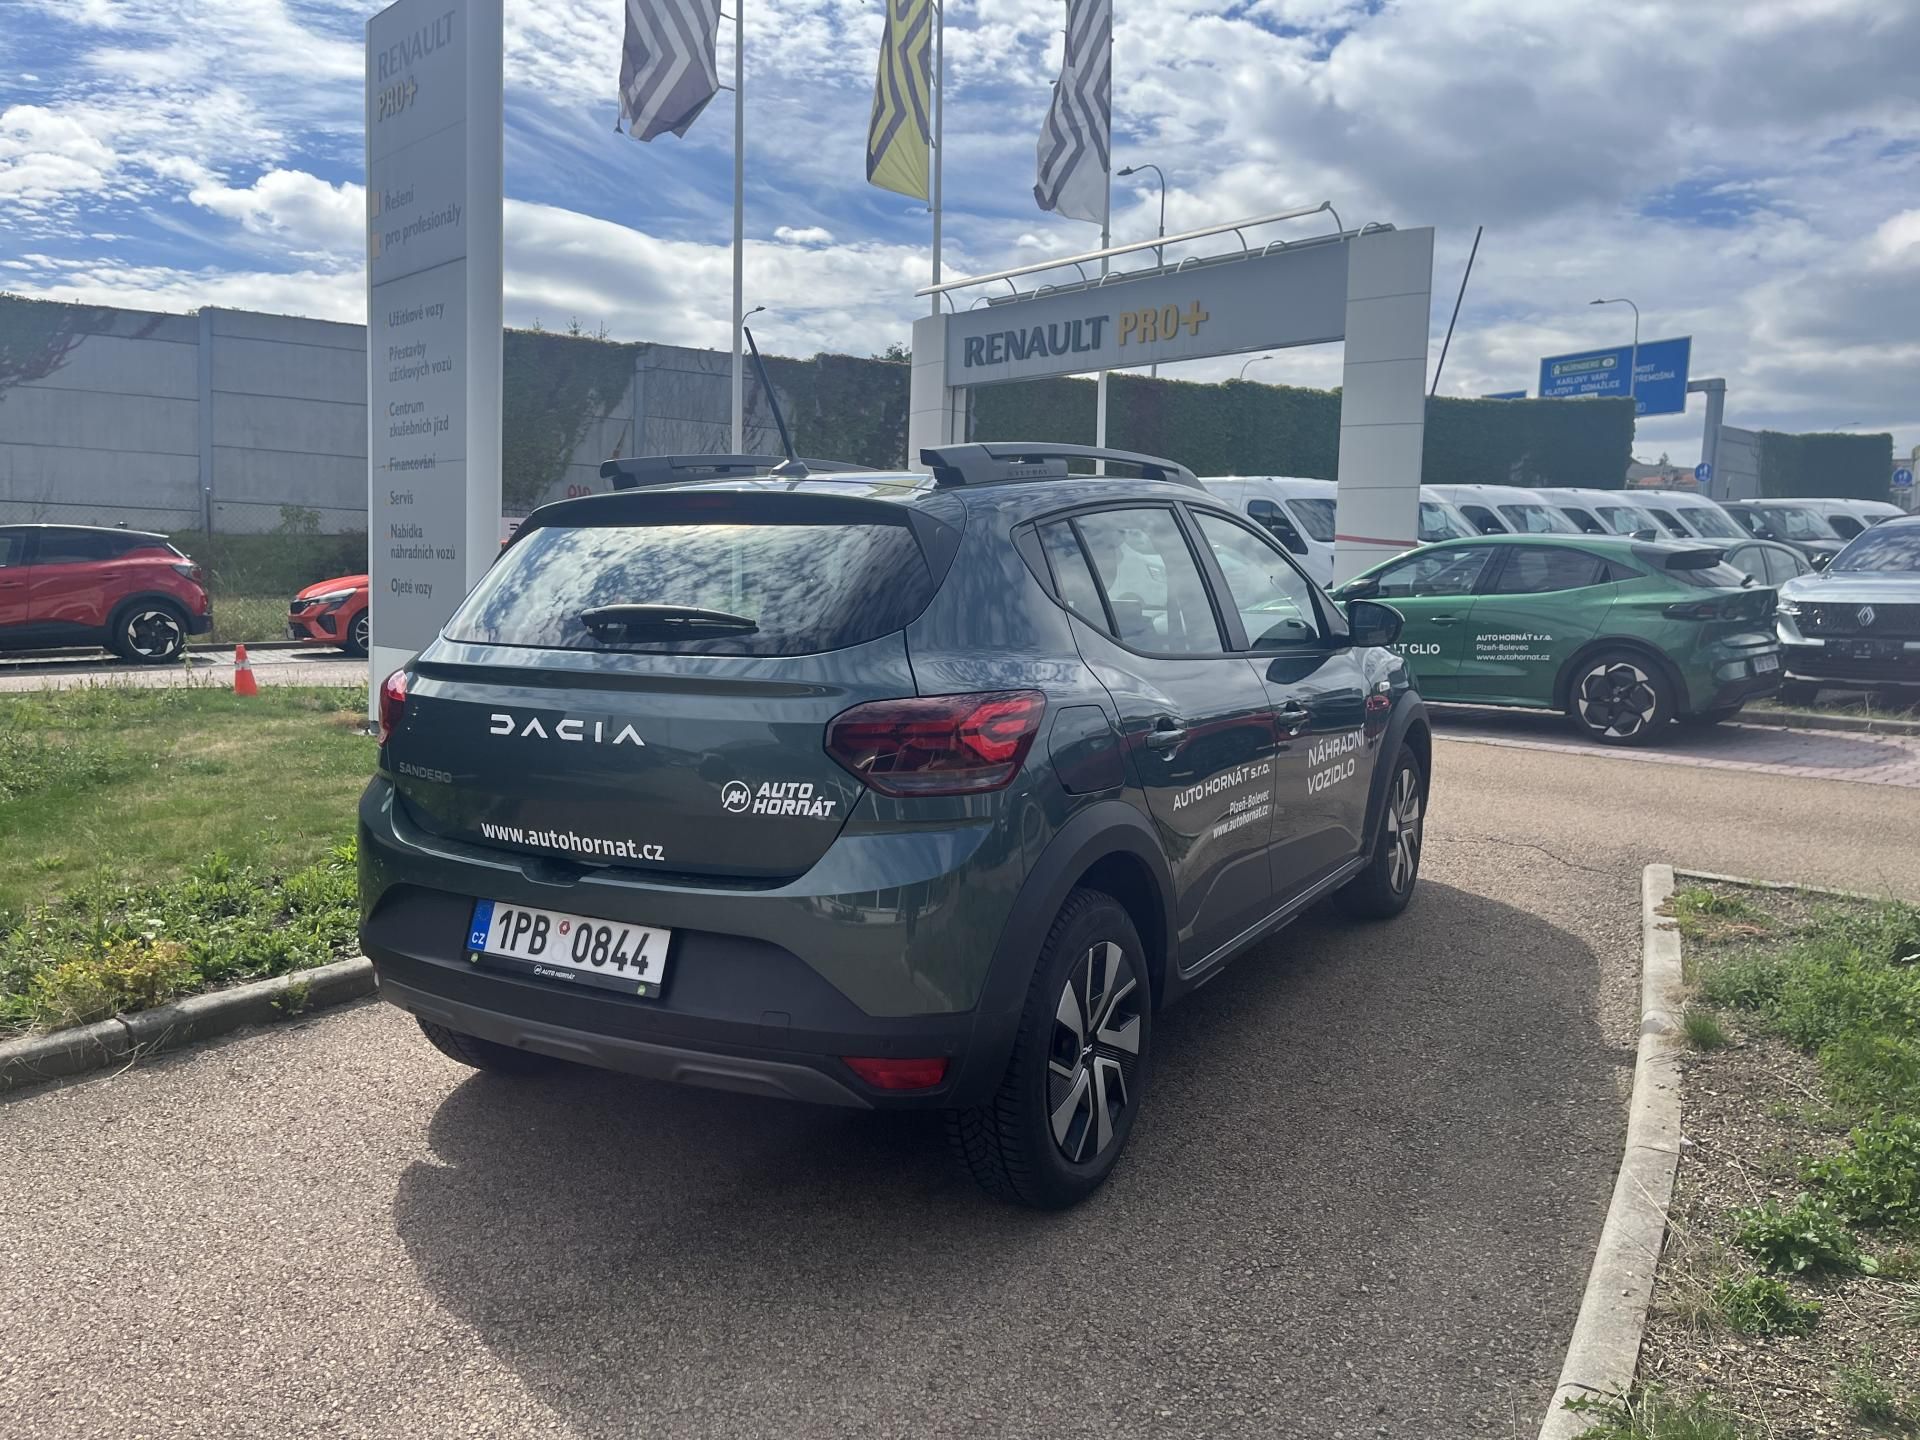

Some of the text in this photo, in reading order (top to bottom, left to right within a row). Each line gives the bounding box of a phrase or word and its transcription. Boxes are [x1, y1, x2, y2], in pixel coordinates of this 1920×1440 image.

[378, 10, 455, 83] RENAULT
[378, 75, 418, 122] PRO+
[385, 184, 414, 212] Řešení
[385, 203, 461, 250] pro profesionály
[389, 302, 445, 328] Užitkové vozy
[963, 300, 1210, 368] RENAULT PRO+
[389, 341, 427, 361] Přestavby
[389, 356, 452, 383] užitkových vozů
[1556, 375, 1588, 387] KARLOVY
[389, 400, 424, 417] Centrum
[389, 415, 449, 438] zkušebních jízd
[389, 453, 436, 472] Financování
[390, 490, 414, 505] Servis
[390, 522, 423, 539] Nabídka
[390, 542, 456, 560] náhradních vozů
[391, 578, 433, 598] Ojeté vozy
[1409, 643, 1441, 654] CLIO
[1499, 633, 1533, 641] HORNÁT
[490, 713, 645, 746] DACIA
[1308, 723, 1365, 768] NÁHRADNÍ
[399, 761, 453, 783] SANDERO
[1307, 758, 1355, 795] VOZIDLO
[756, 782, 814, 799] AUTO
[1173, 763, 1270, 811] AUTO HORNÁT s.r.o.
[752, 796, 837, 817] HORNÁT
[1229, 790, 1270, 815] Plzeň-Bolevec
[1213, 805, 1269, 839] www.autohornat.cz
[481, 822, 665, 861] www.autohornat.cz
[471, 932, 485, 945] CZ
[499, 910, 650, 975] 1PB 0844
[541, 968, 555, 977] AUTO
